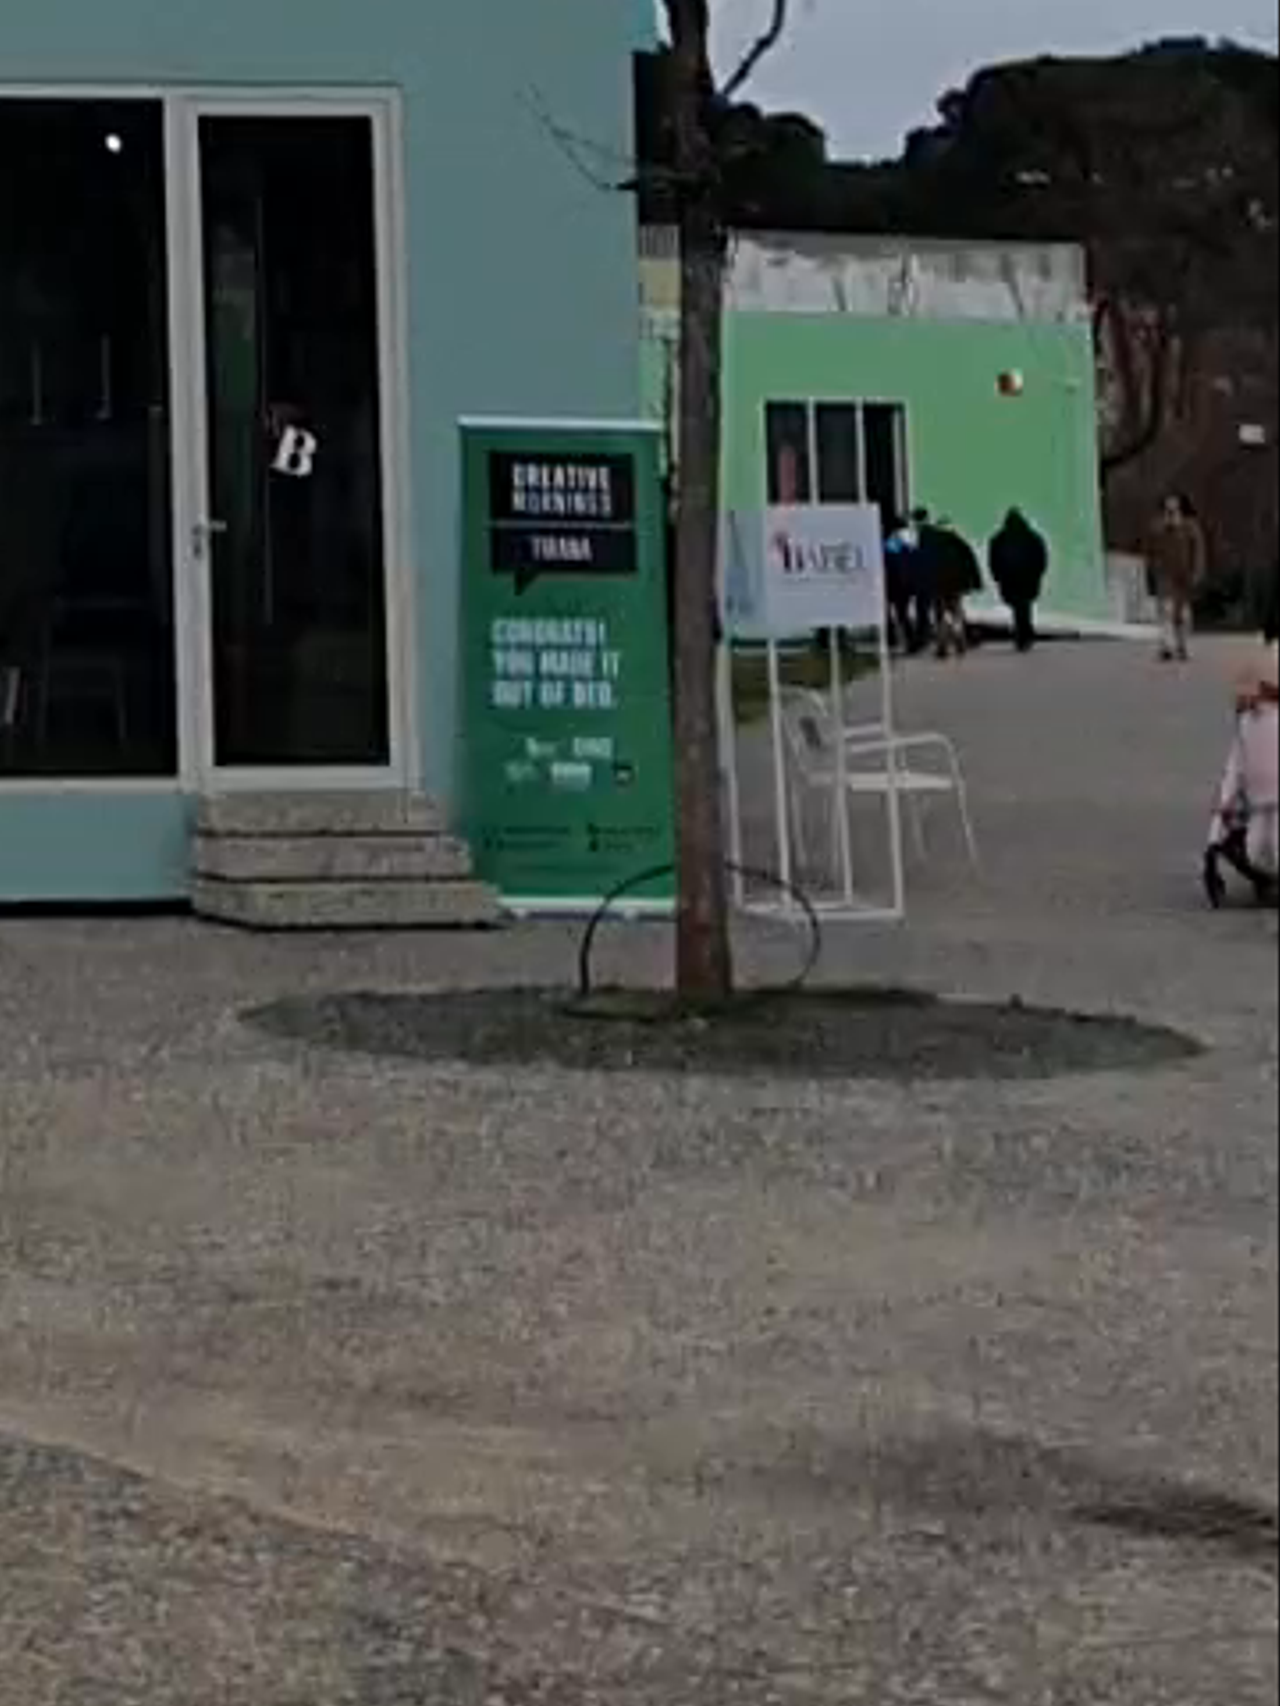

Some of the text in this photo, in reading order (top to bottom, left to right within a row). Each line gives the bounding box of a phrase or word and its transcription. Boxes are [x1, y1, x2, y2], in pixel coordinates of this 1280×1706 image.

[270, 424, 317, 476] B
[512, 461, 610, 489] CREATIVE
[601, 650, 621, 679] IT
